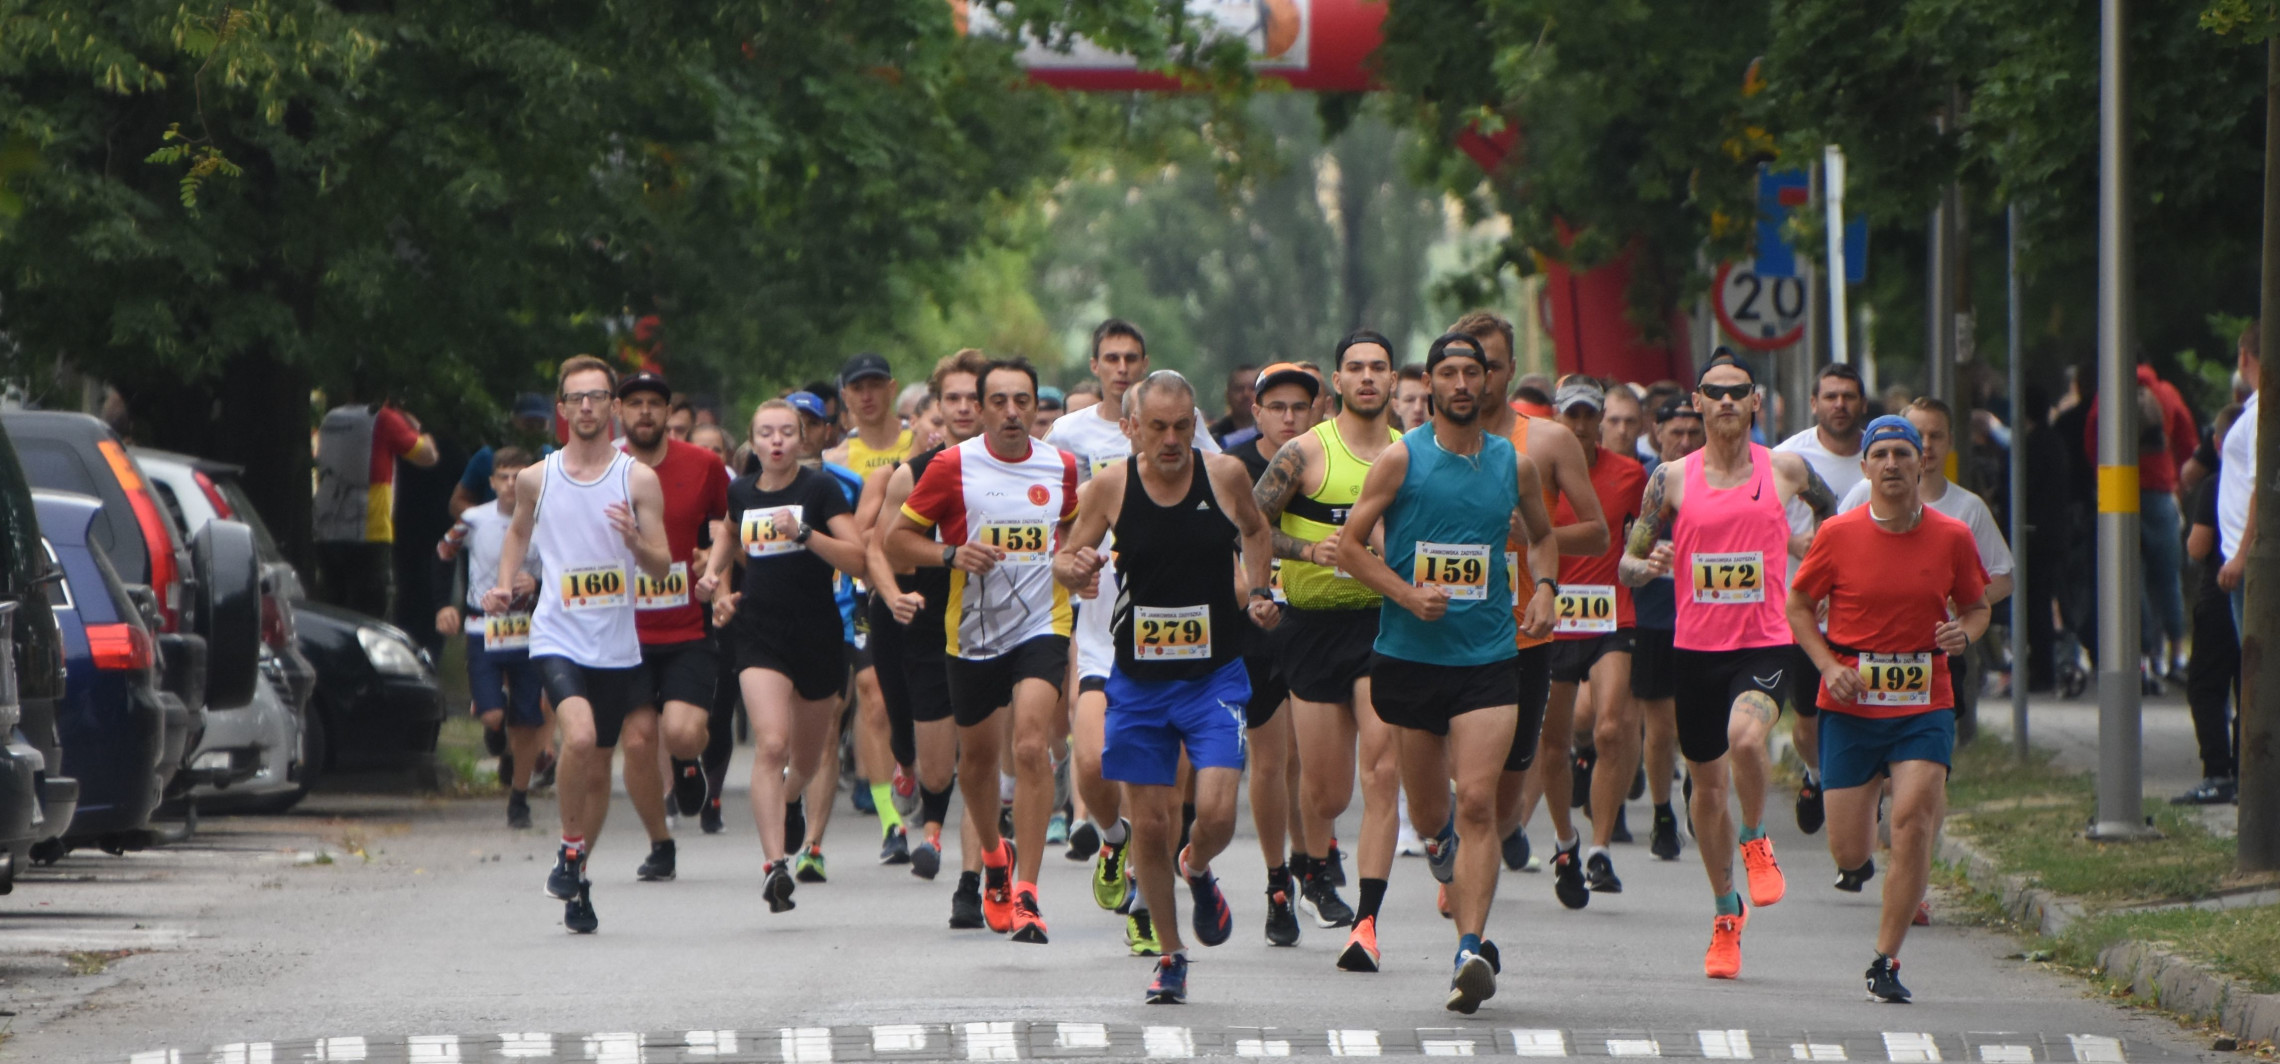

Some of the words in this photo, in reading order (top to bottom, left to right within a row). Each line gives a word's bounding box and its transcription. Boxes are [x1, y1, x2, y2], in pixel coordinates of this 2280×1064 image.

[1733, 272, 1804, 319] 20
[991, 526, 1042, 551] 153
[1425, 557, 1482, 584] 159
[1703, 564, 1756, 588] 172
[569, 571, 620, 598] 160
[637, 572, 682, 598] 190
[1560, 596, 1609, 618] 210
[492, 615, 529, 637] 132
[1142, 620, 1202, 645] 279
[1869, 666, 1923, 690] 192
